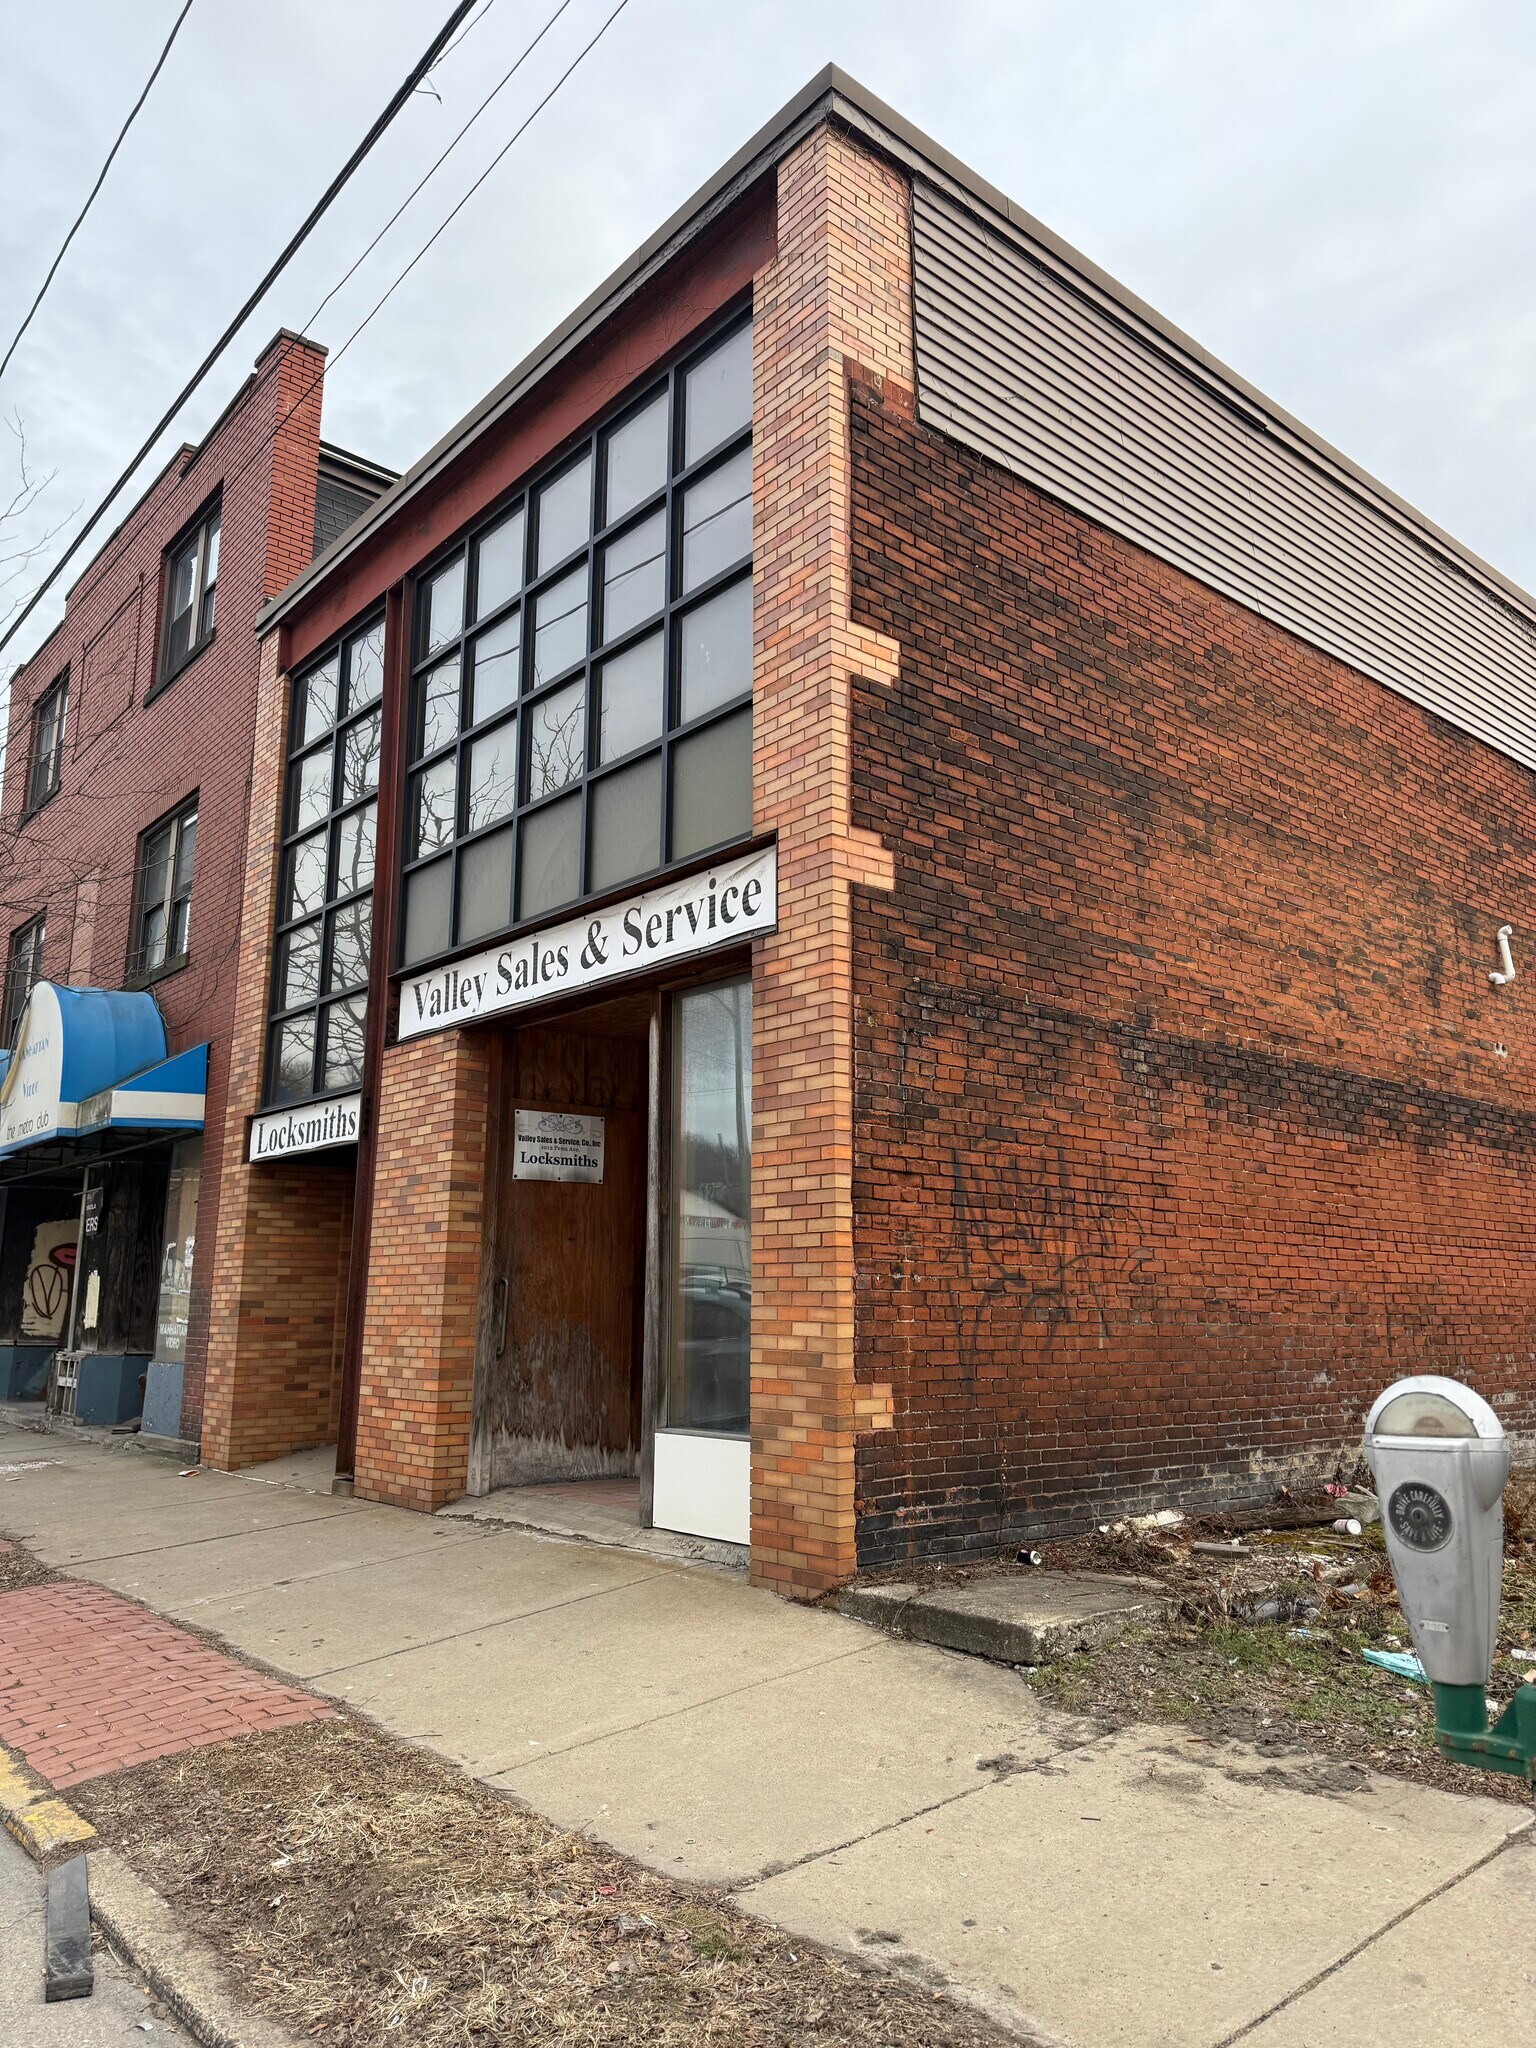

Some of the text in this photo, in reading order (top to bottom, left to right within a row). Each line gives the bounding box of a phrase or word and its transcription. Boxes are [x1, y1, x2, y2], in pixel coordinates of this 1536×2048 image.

[412, 877, 763, 1021] Valley Sales & Service
[7, 1124, 16, 1140] the
[18, 1118, 34, 1136] metro
[256, 1104, 357, 1154] Locksmiths
[518, 1134, 536, 1143] Valley
[537, 1135, 553, 1144] Sales
[520, 1151, 598, 1168] Locksmiths
[1395, 1490, 1444, 1518] DRIVE CAREFULLY
